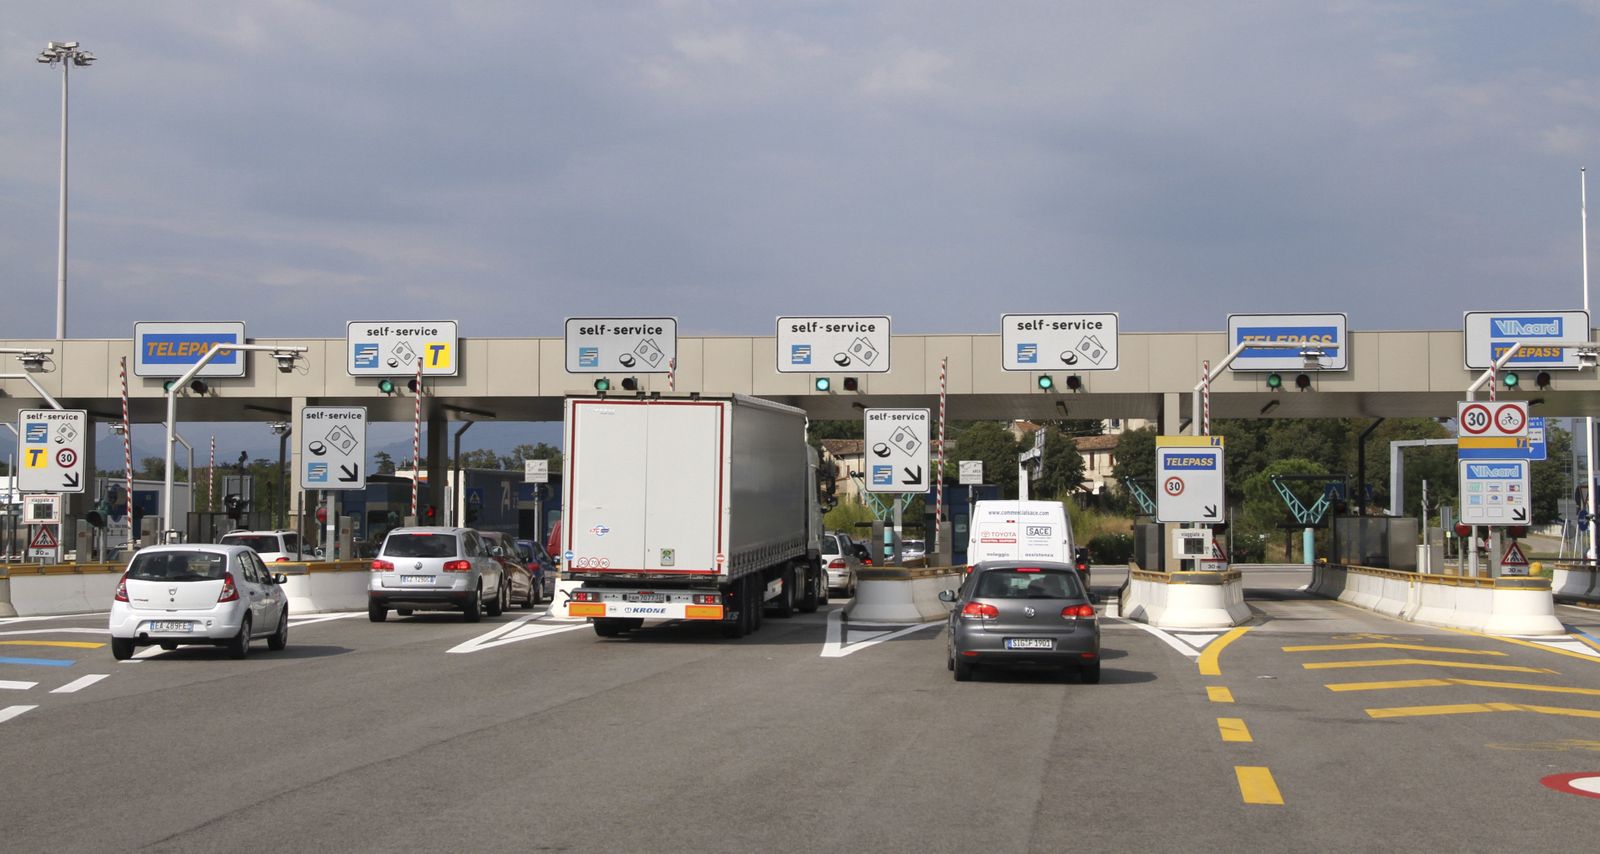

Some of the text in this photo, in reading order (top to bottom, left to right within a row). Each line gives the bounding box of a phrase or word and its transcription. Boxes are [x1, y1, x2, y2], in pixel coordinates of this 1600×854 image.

[579, 324, 663, 335] self-service
[791, 322, 876, 333] self-service
[1017, 320, 1103, 330] self-service
[366, 327, 438, 336] self-service
[26, 412, 79, 420] self-service
[306, 411, 362, 419] self-service
[869, 412, 925, 420] self-service
[1468, 412, 1485, 427] 30
[29, 449, 43, 467] T
[60, 453, 72, 463] 30
[1167, 457, 1214, 466] TELEPASS
[1169, 482, 1180, 491] 30
[1029, 527, 1049, 536] SACE
